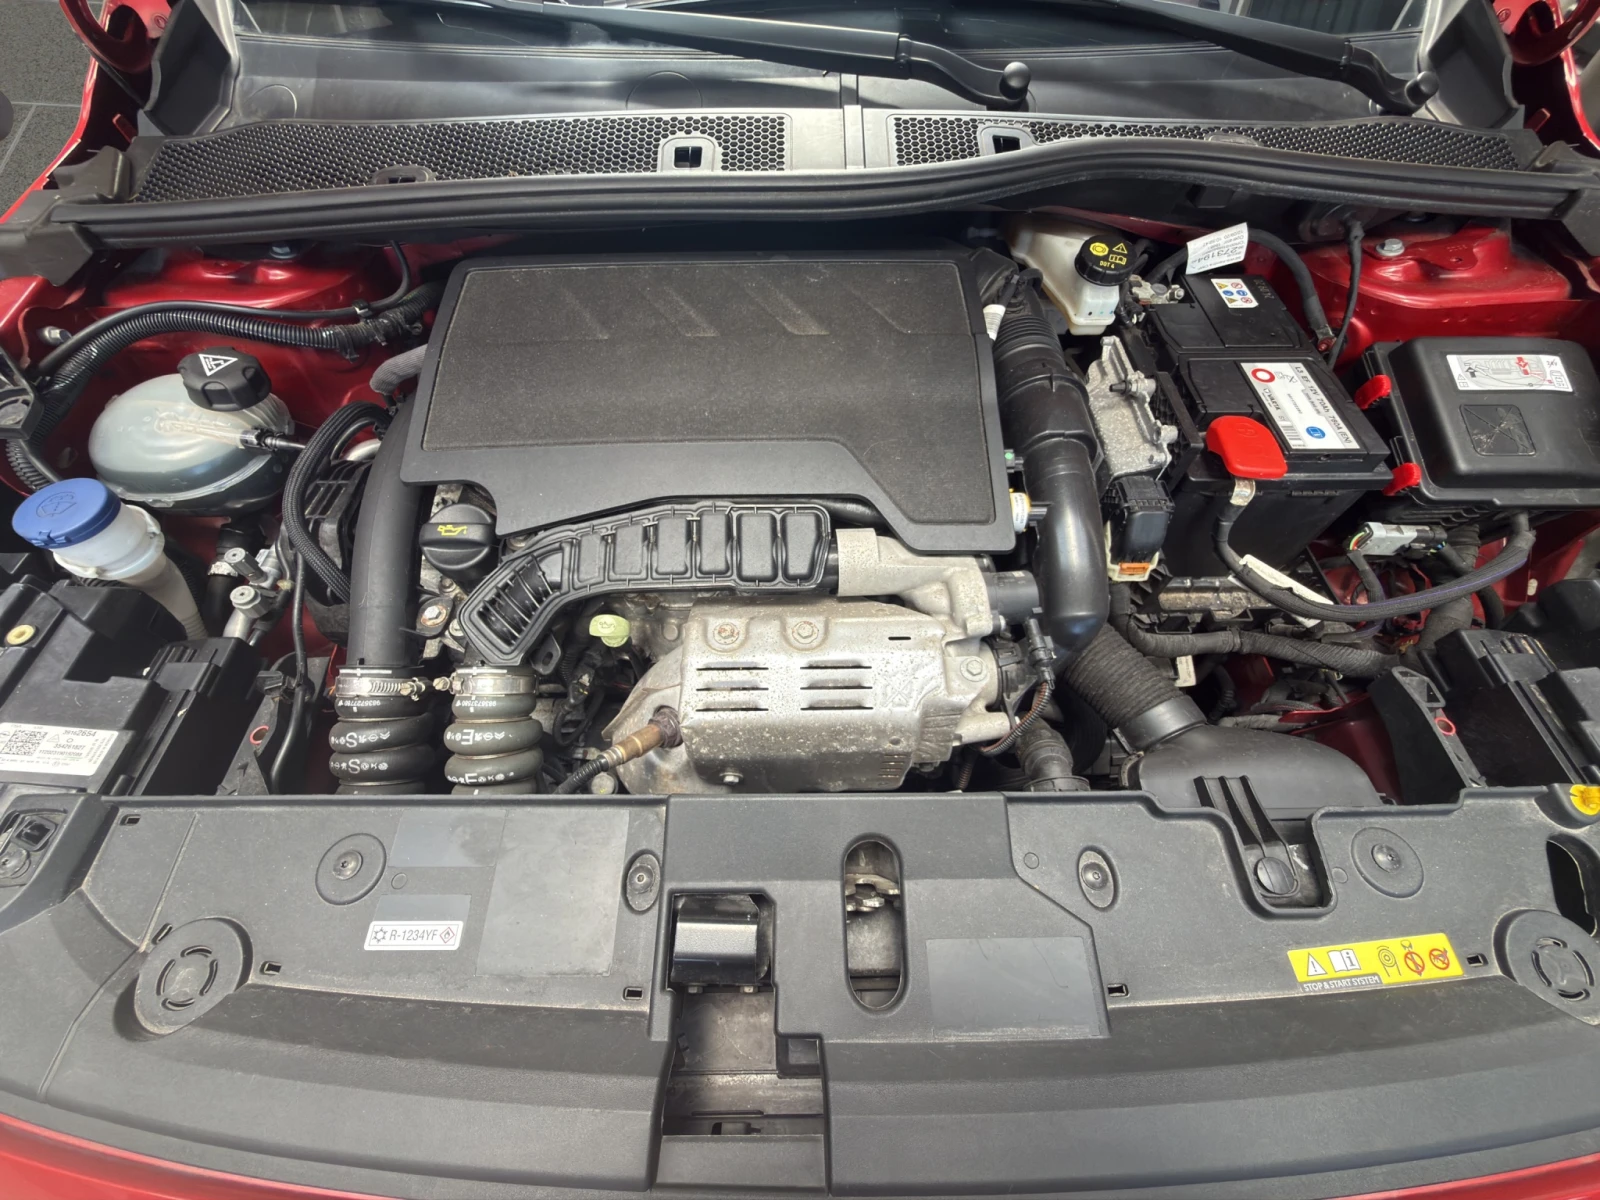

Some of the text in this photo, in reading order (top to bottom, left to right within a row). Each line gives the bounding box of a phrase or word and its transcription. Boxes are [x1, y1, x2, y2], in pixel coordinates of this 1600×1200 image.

[1099, 260, 1111, 268] DOT
[388, 929, 439, 941] R-1234YF
[1303, 975, 1380, 992] STOP & START SYSTEM
